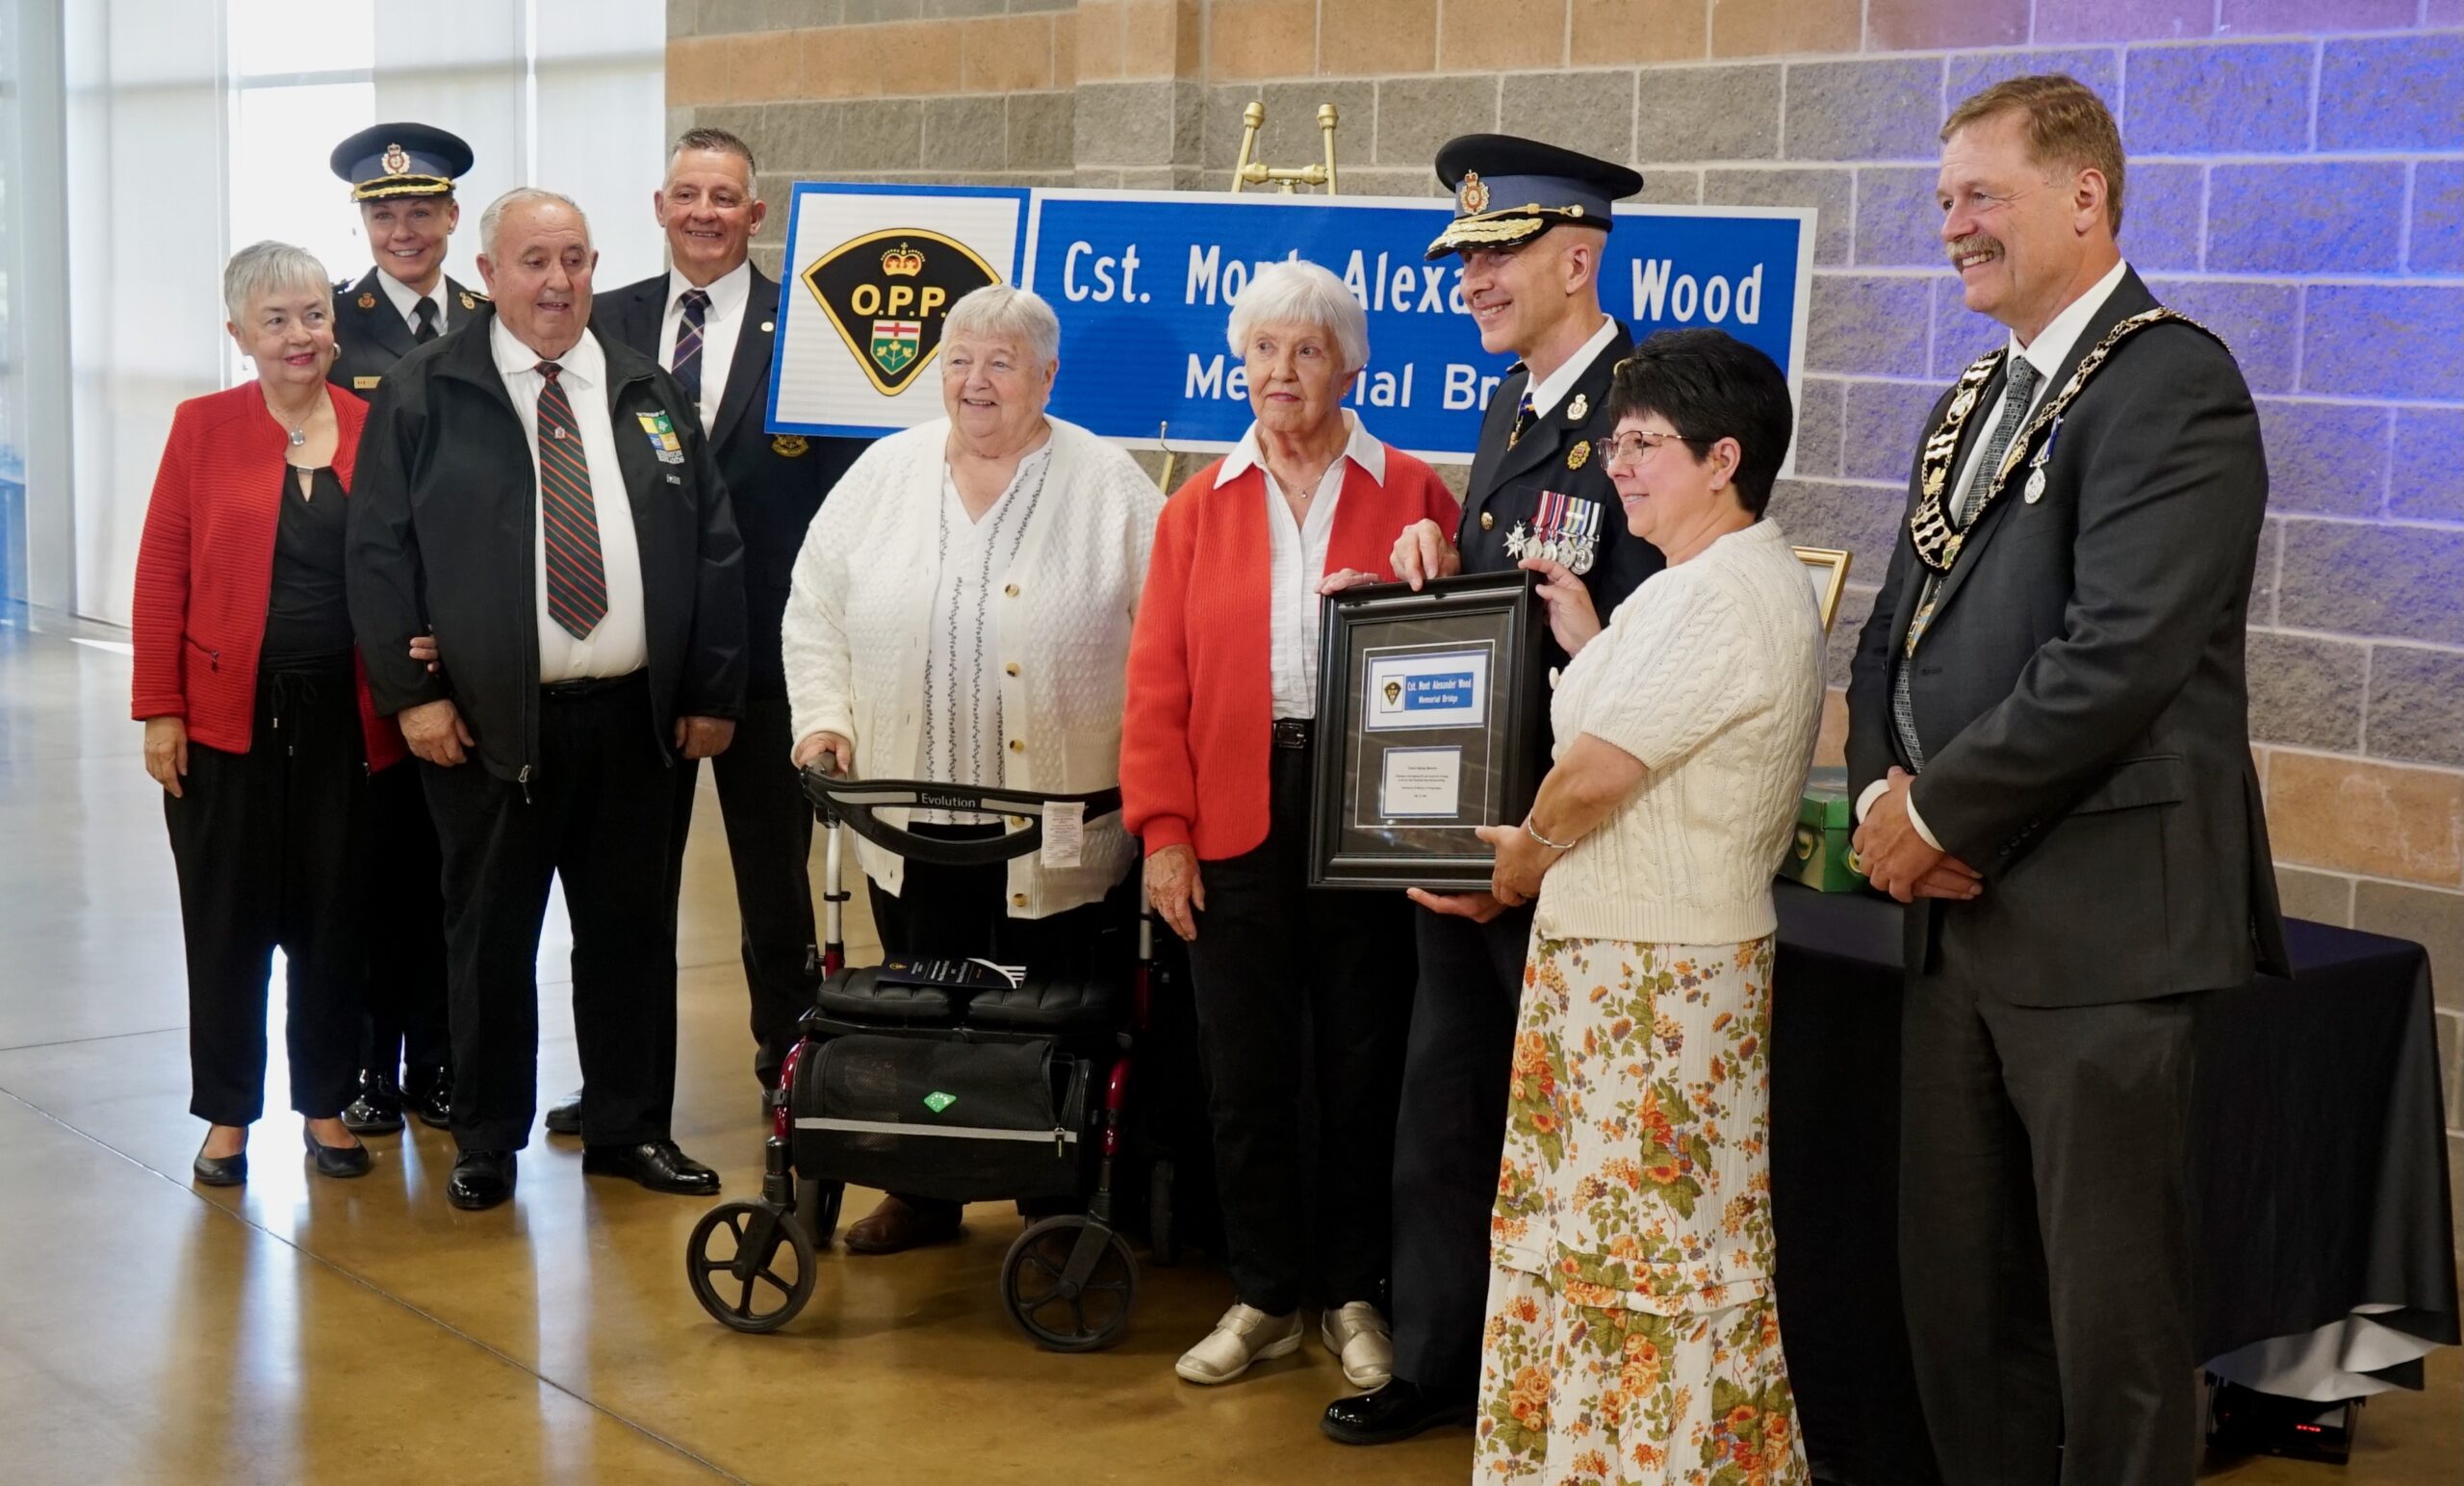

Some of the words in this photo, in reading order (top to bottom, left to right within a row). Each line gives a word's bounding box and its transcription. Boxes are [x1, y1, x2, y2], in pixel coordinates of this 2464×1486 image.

[851, 283, 947, 319] O.P.P.
[1064, 240, 1151, 304] Cst.
[1185, 244, 1298, 307] Mo
[1631, 258, 1763, 324] Wood
[1185, 353, 1414, 408] Meial
[921, 792, 976, 808] Evolution
